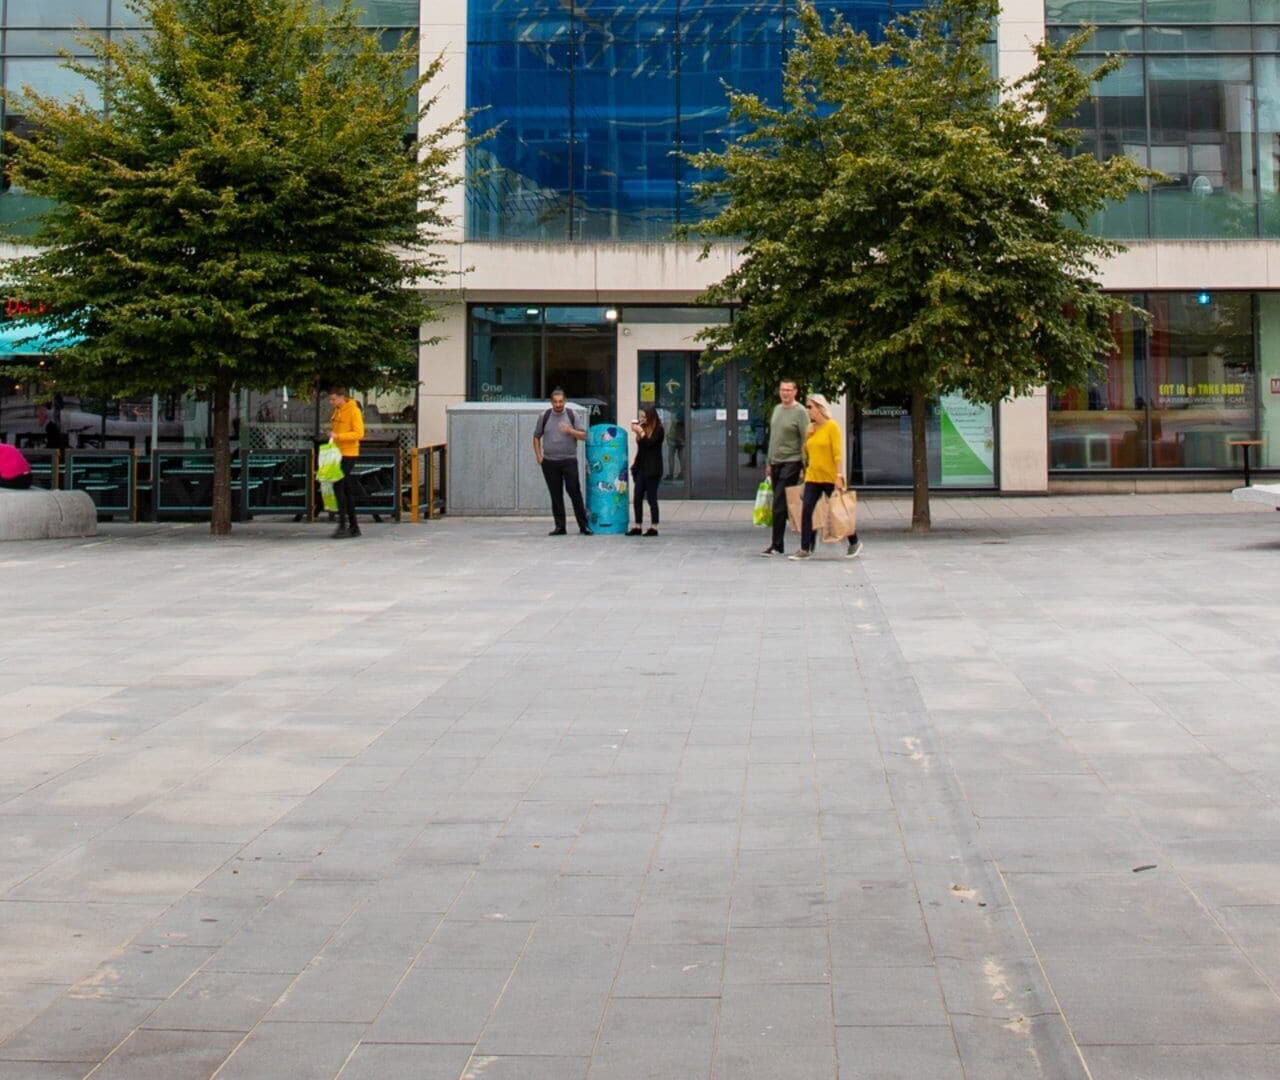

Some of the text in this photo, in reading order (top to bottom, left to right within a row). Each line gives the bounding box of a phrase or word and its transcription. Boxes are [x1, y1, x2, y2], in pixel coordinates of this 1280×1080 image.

[481, 382, 503, 393] One
[1197, 383, 1219, 395] TAKE
[861, 406, 908, 418] Southampton
